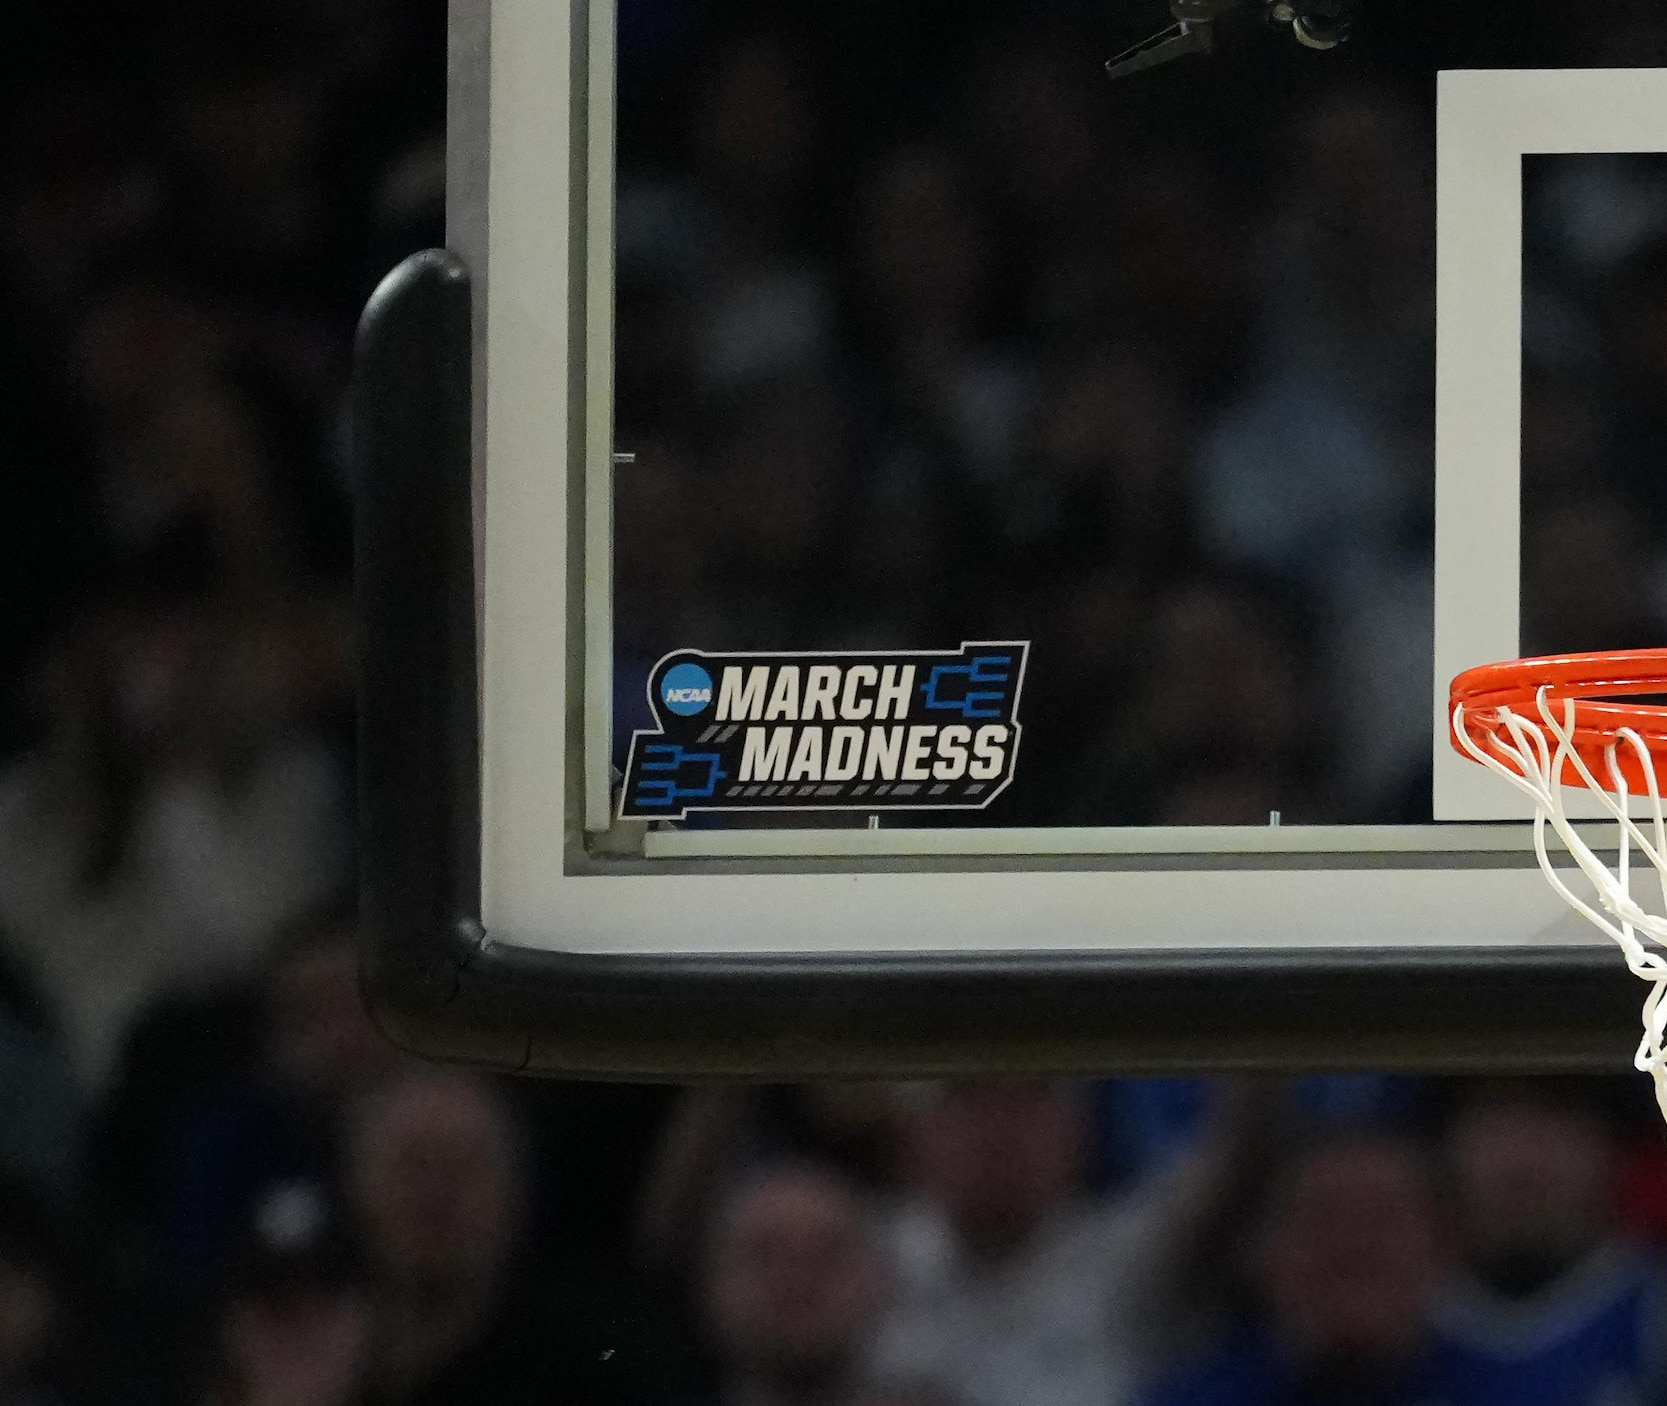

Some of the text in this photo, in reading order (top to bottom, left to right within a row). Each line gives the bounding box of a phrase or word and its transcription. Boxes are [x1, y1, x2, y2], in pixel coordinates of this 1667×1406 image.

[665, 687, 712, 703] NCAA
[714, 664, 916, 721] MARCH
[737, 724, 1009, 782] MADNESS
